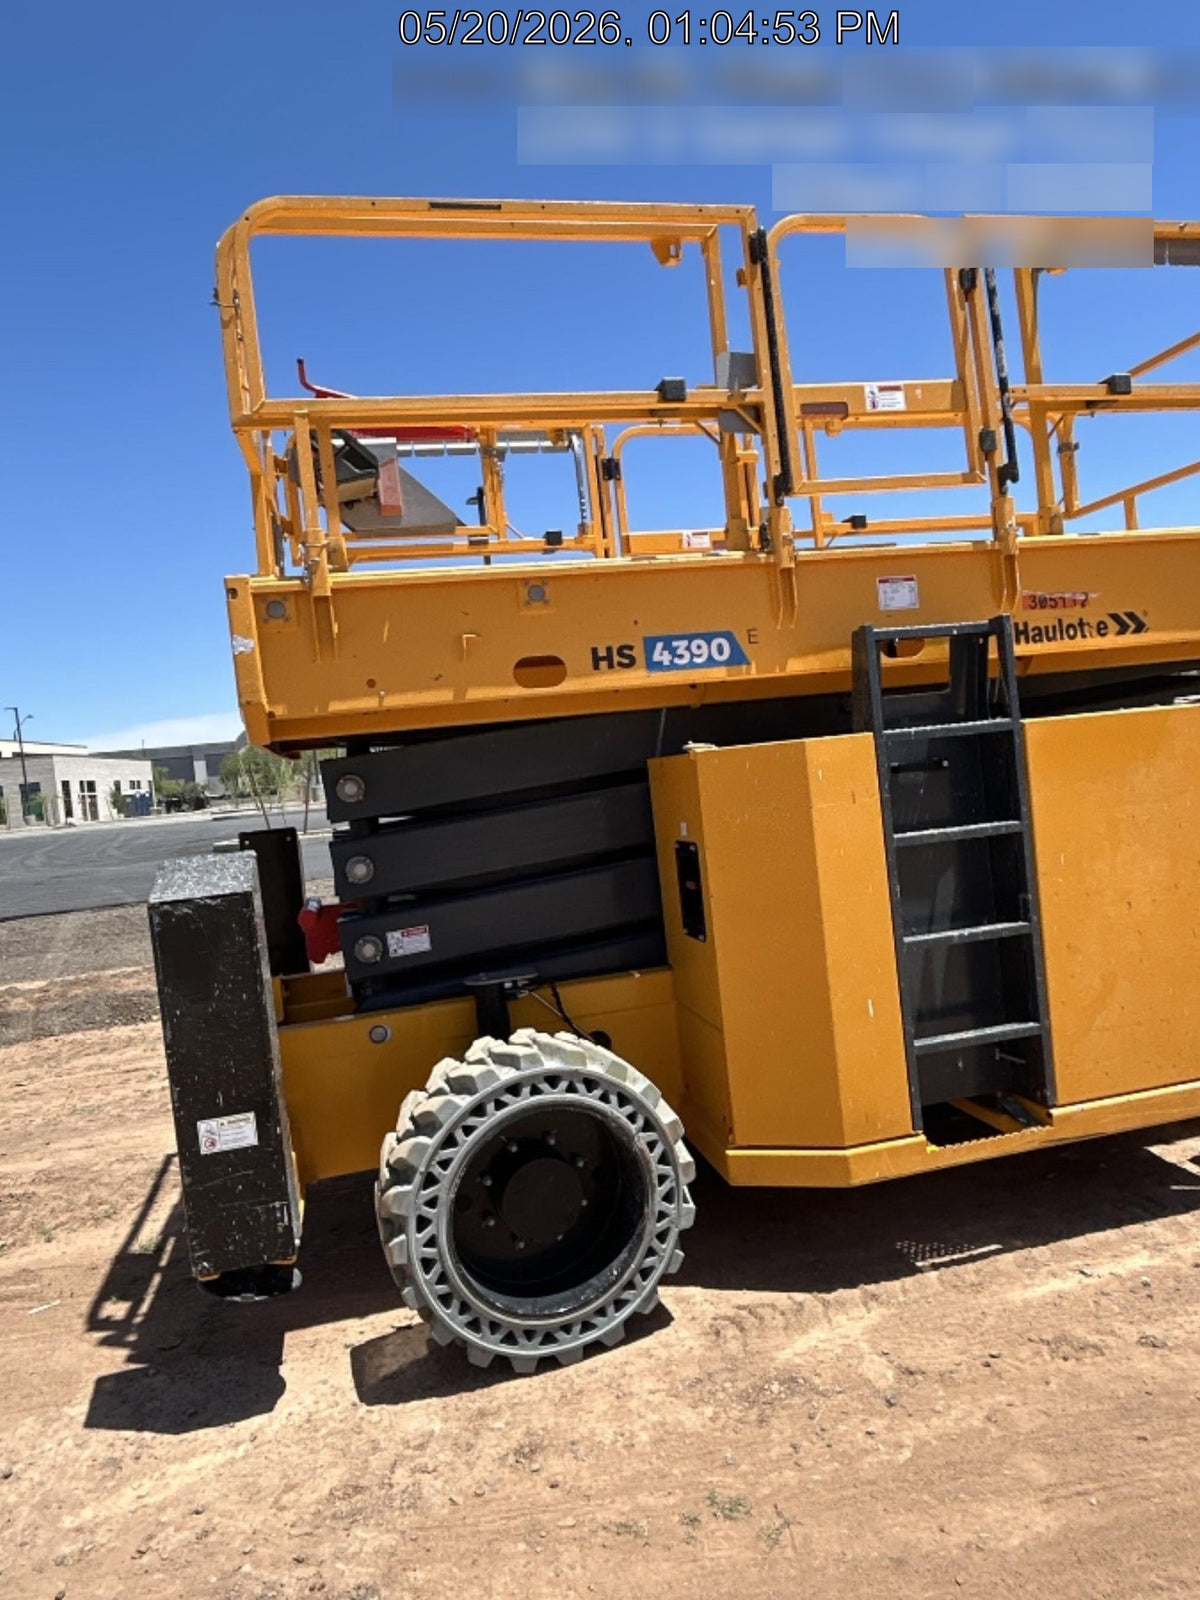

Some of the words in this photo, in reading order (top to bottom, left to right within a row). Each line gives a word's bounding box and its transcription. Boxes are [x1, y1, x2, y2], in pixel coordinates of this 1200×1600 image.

[591, 644, 637, 671] HS
[652, 637, 732, 666] 4390
[746, 628, 759, 645] E
